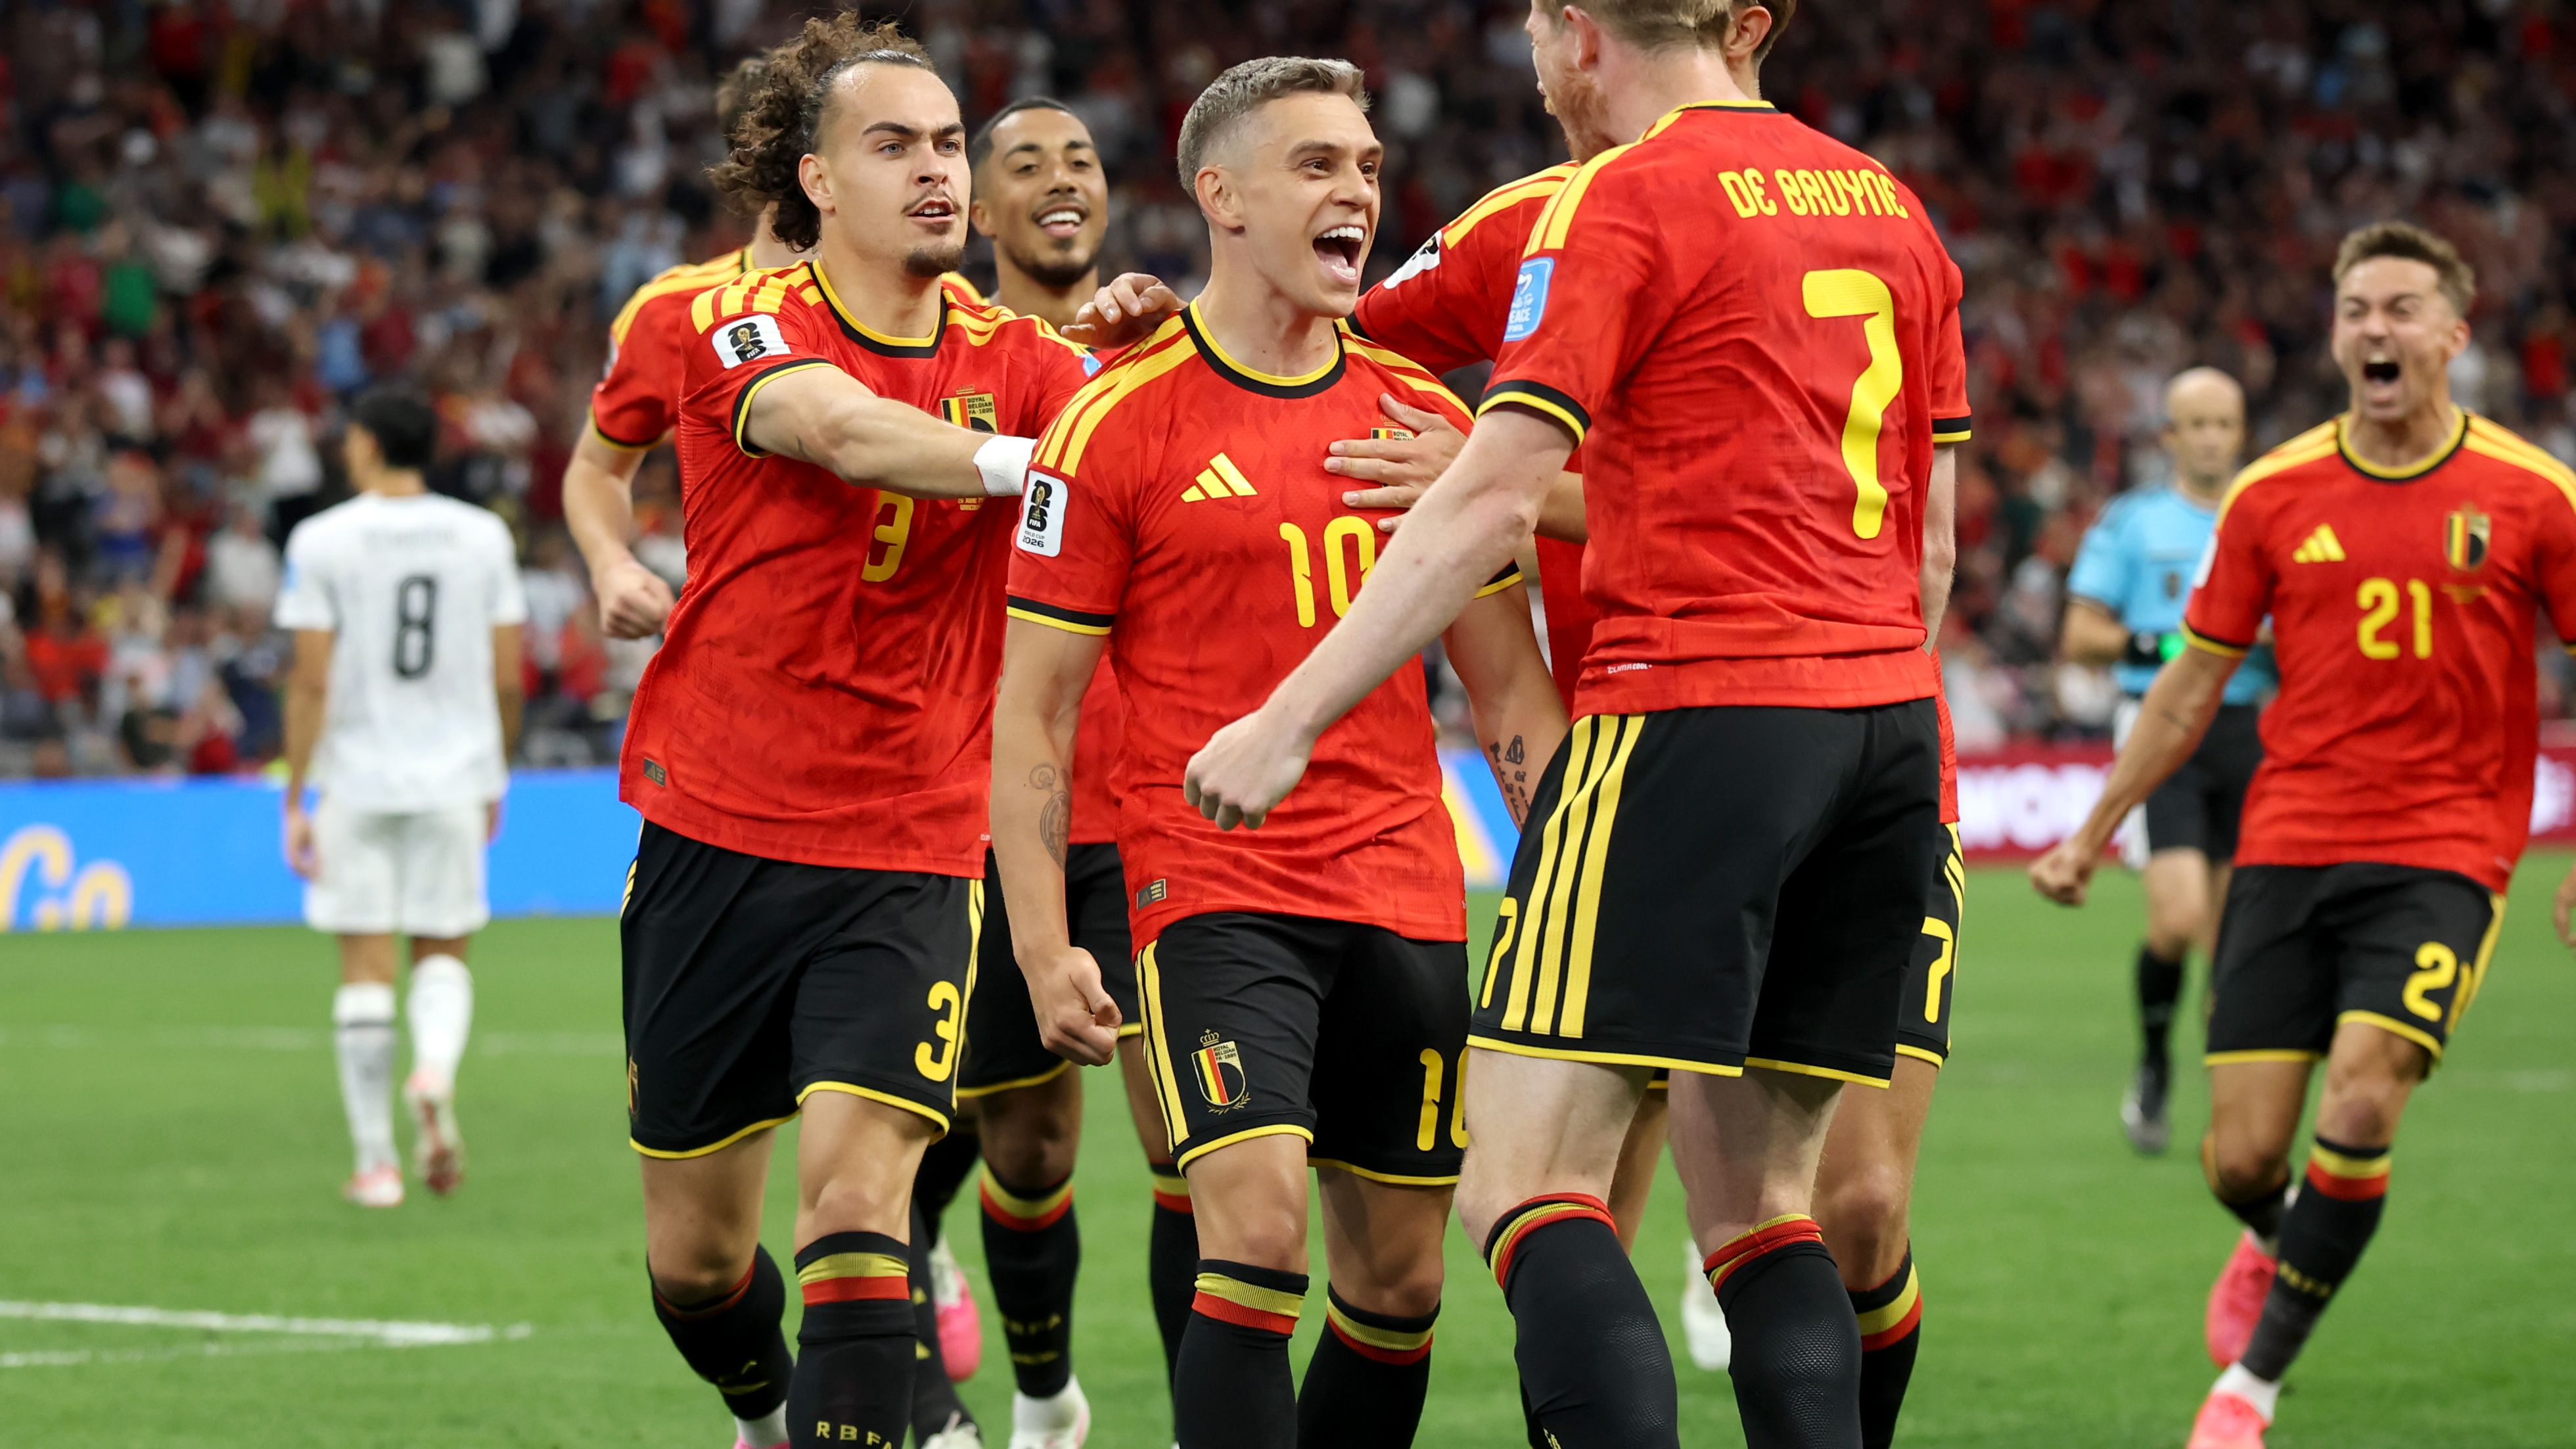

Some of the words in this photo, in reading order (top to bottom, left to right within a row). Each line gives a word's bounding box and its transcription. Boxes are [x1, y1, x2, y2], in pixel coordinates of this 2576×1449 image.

[1718, 168, 1778, 218] DE
[1774, 169, 1908, 219] BRUYNE
[1507, 308, 1530, 323] EACE
[1802, 269, 1902, 539] 7
[861, 490, 914, 582] 3
[1279, 516, 1375, 628] 10
[396, 574, 437, 679] 8
[2357, 577, 2432, 660] 21
[1481, 897, 1517, 1009] 7
[1921, 916, 1954, 1024] 7
[915, 980, 960, 1082] 3
